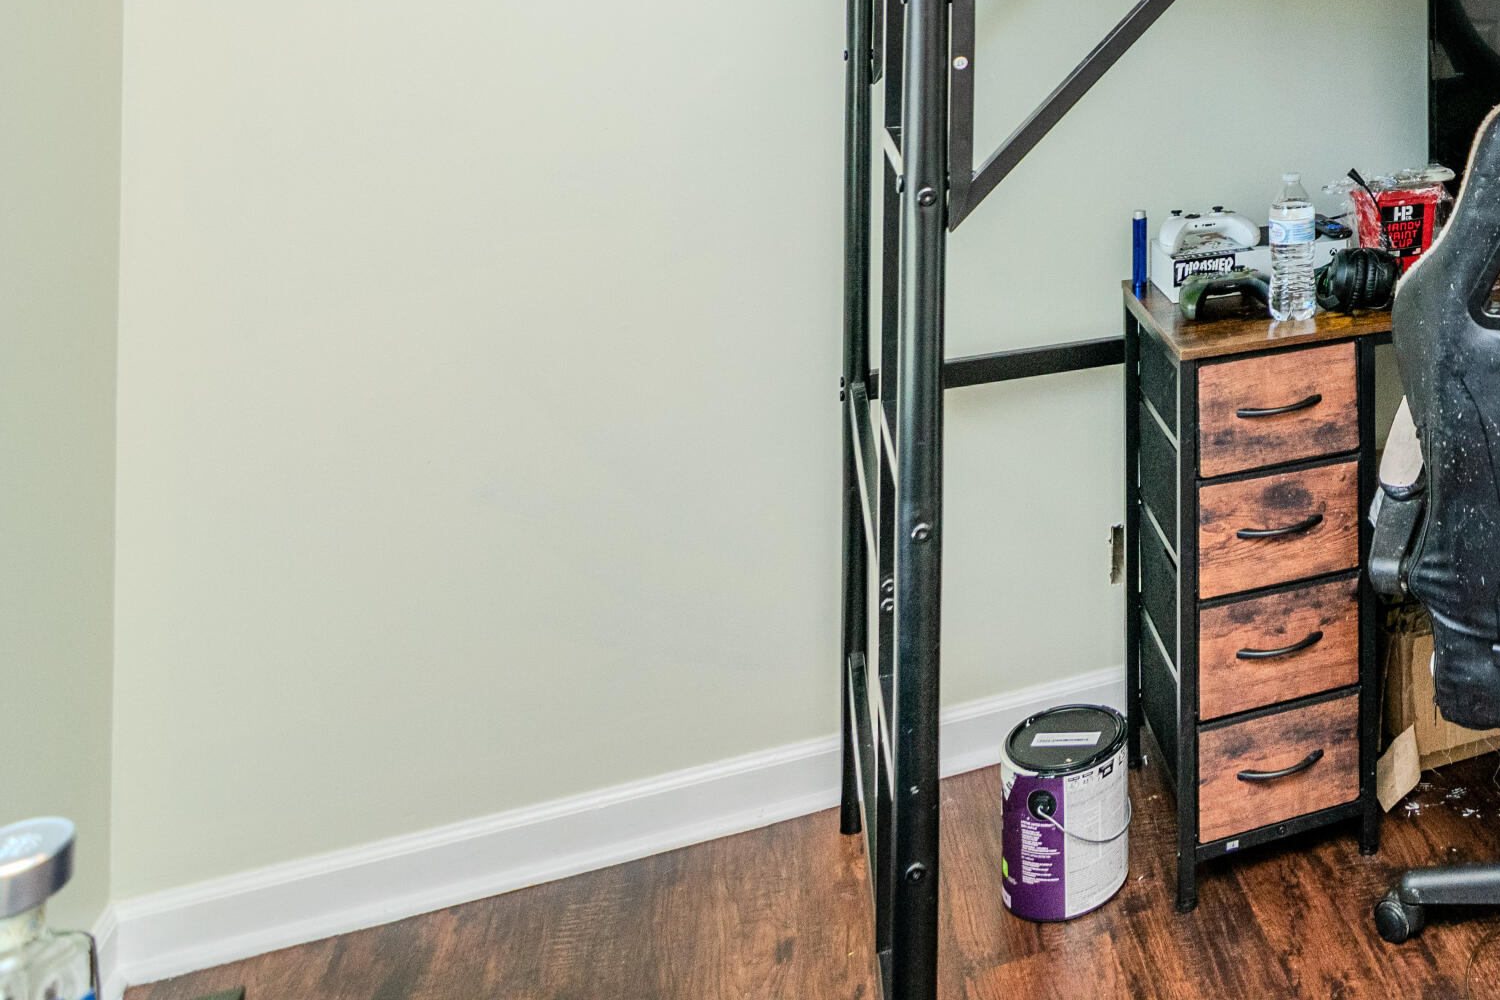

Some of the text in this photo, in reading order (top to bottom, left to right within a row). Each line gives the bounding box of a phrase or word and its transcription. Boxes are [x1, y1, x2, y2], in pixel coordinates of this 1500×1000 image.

[1393, 205, 1413, 221] HP
[1391, 239, 1412, 248] CUP
[1175, 256, 1234, 282] THRASHER
